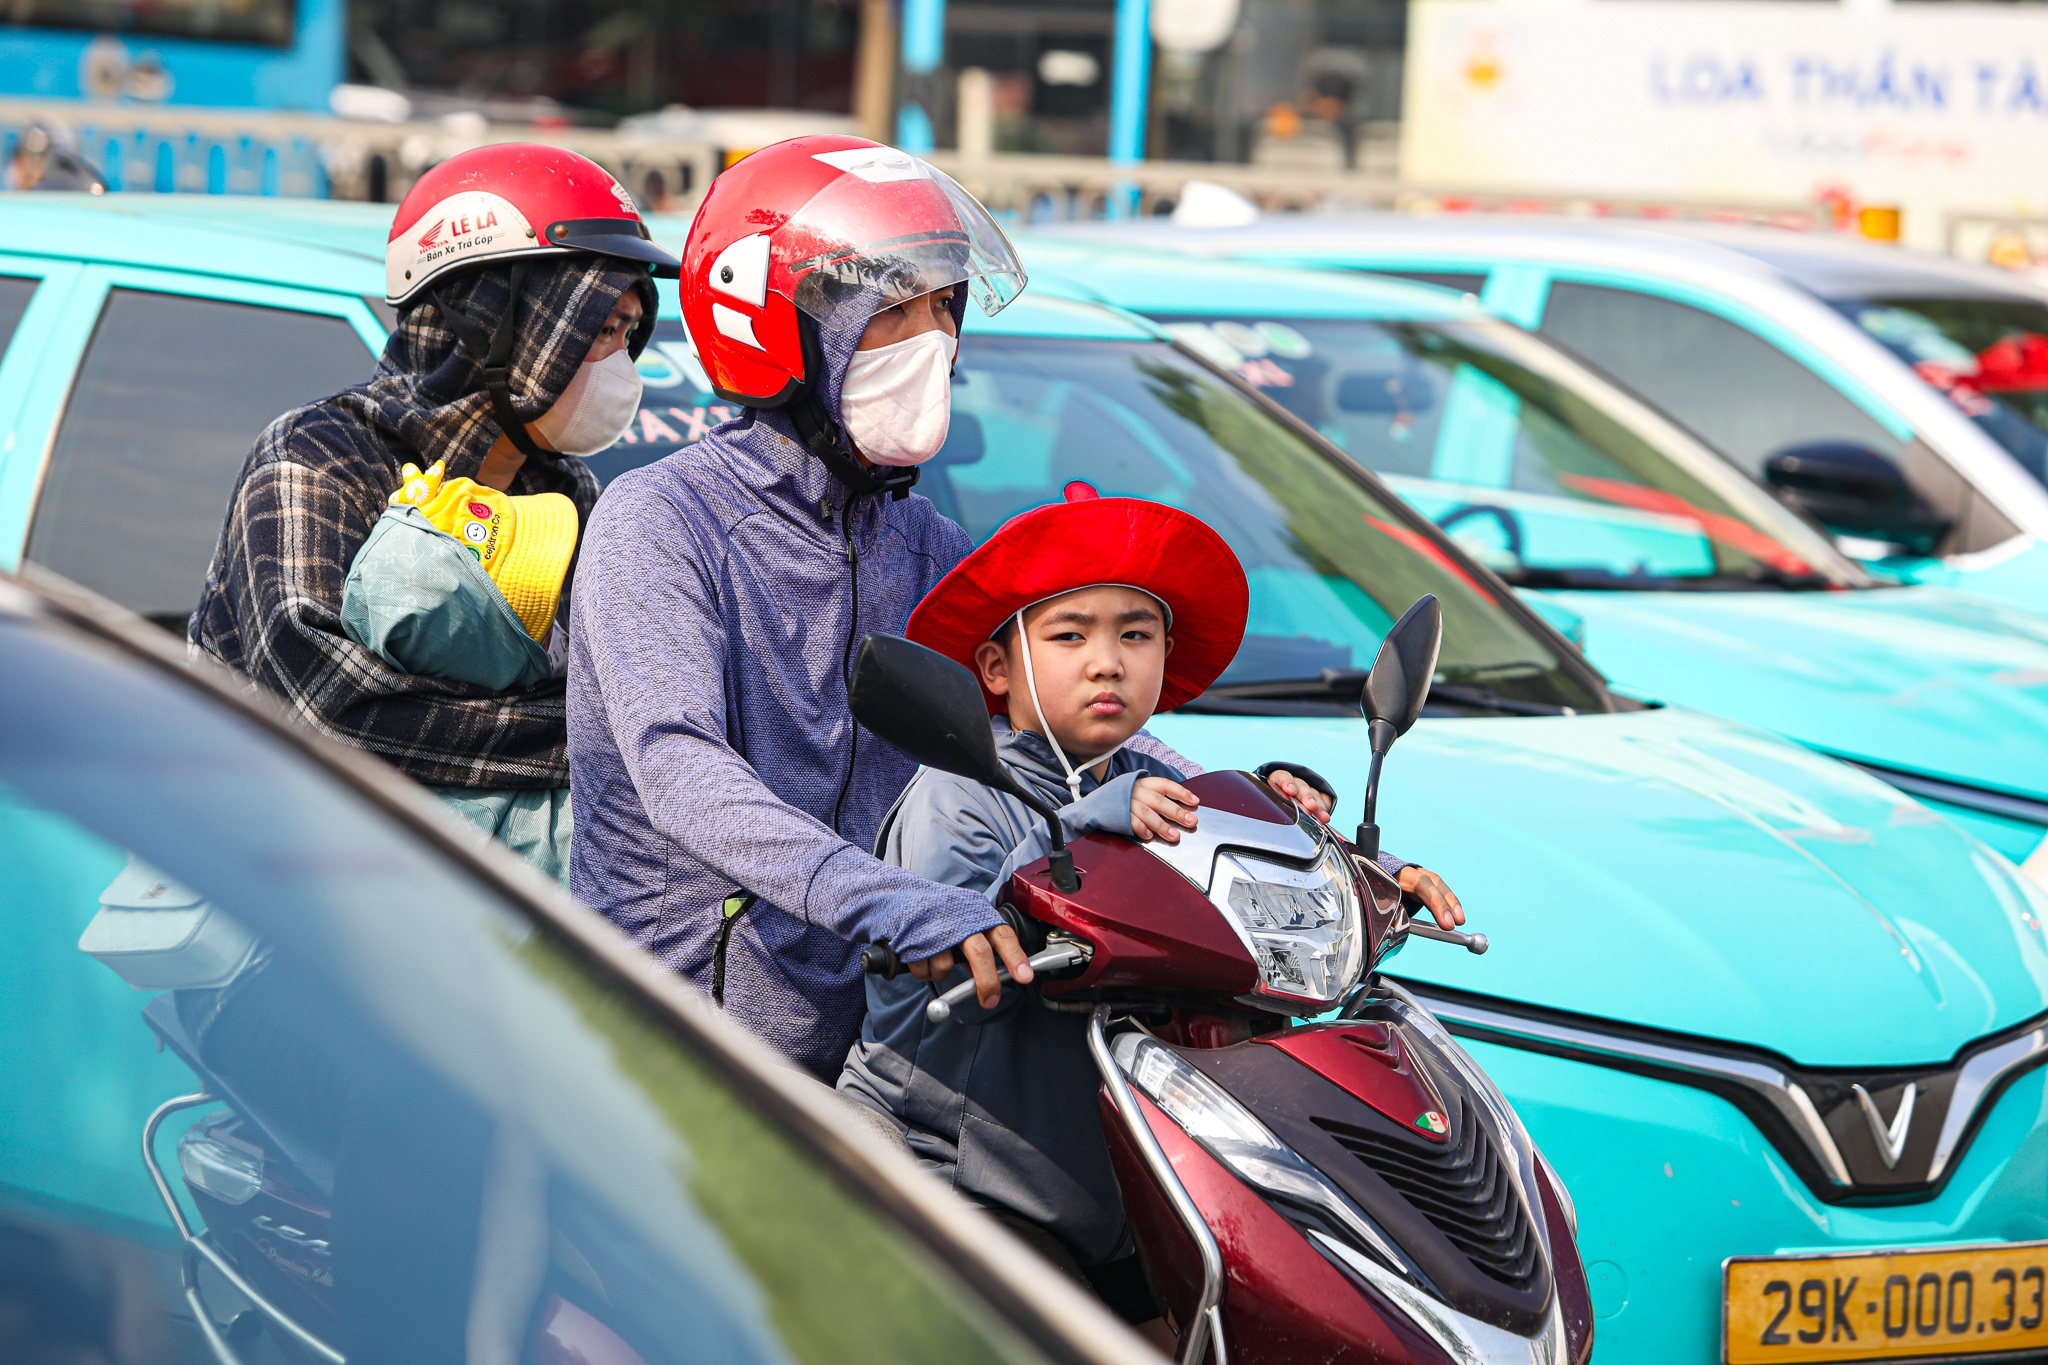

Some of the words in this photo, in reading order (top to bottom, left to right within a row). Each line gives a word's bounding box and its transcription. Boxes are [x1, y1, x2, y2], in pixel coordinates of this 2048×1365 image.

[1648, 50, 1766, 107] LOA
[419, 239, 449, 255] HONDA
[445, 244, 455, 255] Xe
[1760, 1266, 2044, 1345] 29K-000.33
